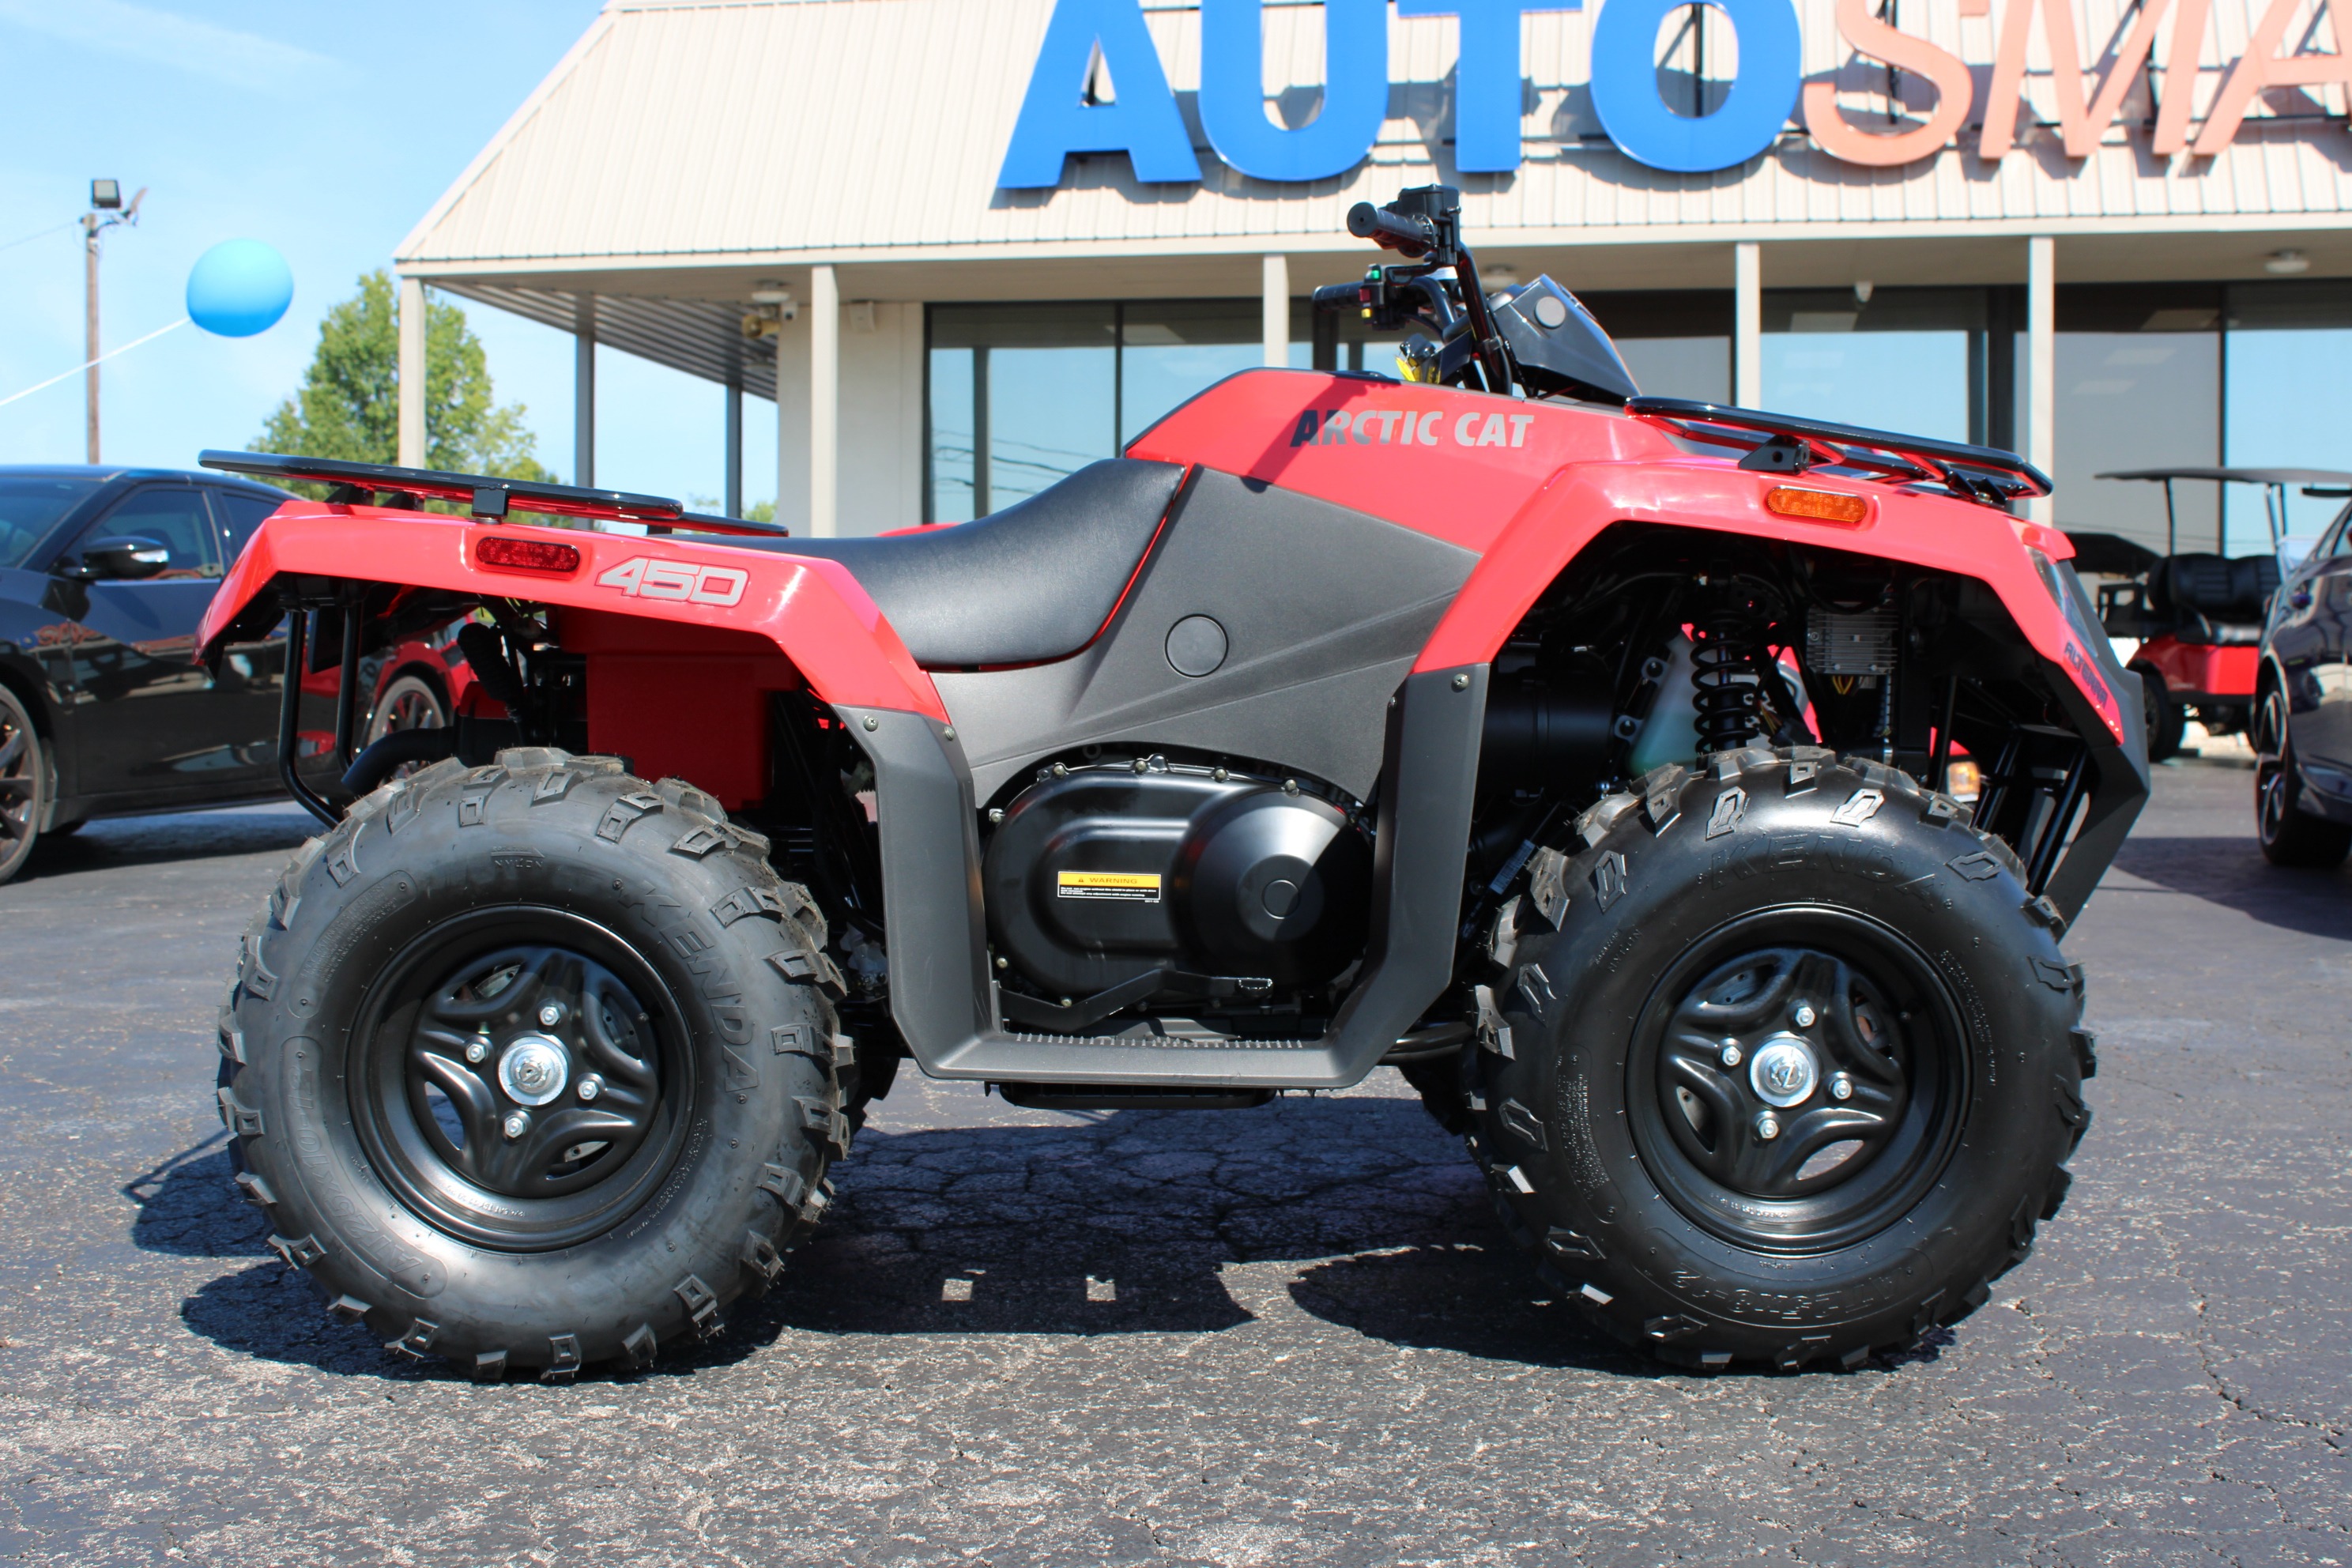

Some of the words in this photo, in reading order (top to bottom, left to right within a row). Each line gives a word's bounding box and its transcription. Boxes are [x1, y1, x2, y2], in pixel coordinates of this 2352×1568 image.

[1290, 409, 1444, 448] ARCTIC
[1454, 412, 1535, 448] CAT
[596, 556, 749, 607] 450
[2065, 643, 2108, 709] ALTERRA
[1710, 833, 1947, 914] KENDA
[617, 880, 759, 1093] KENDA
